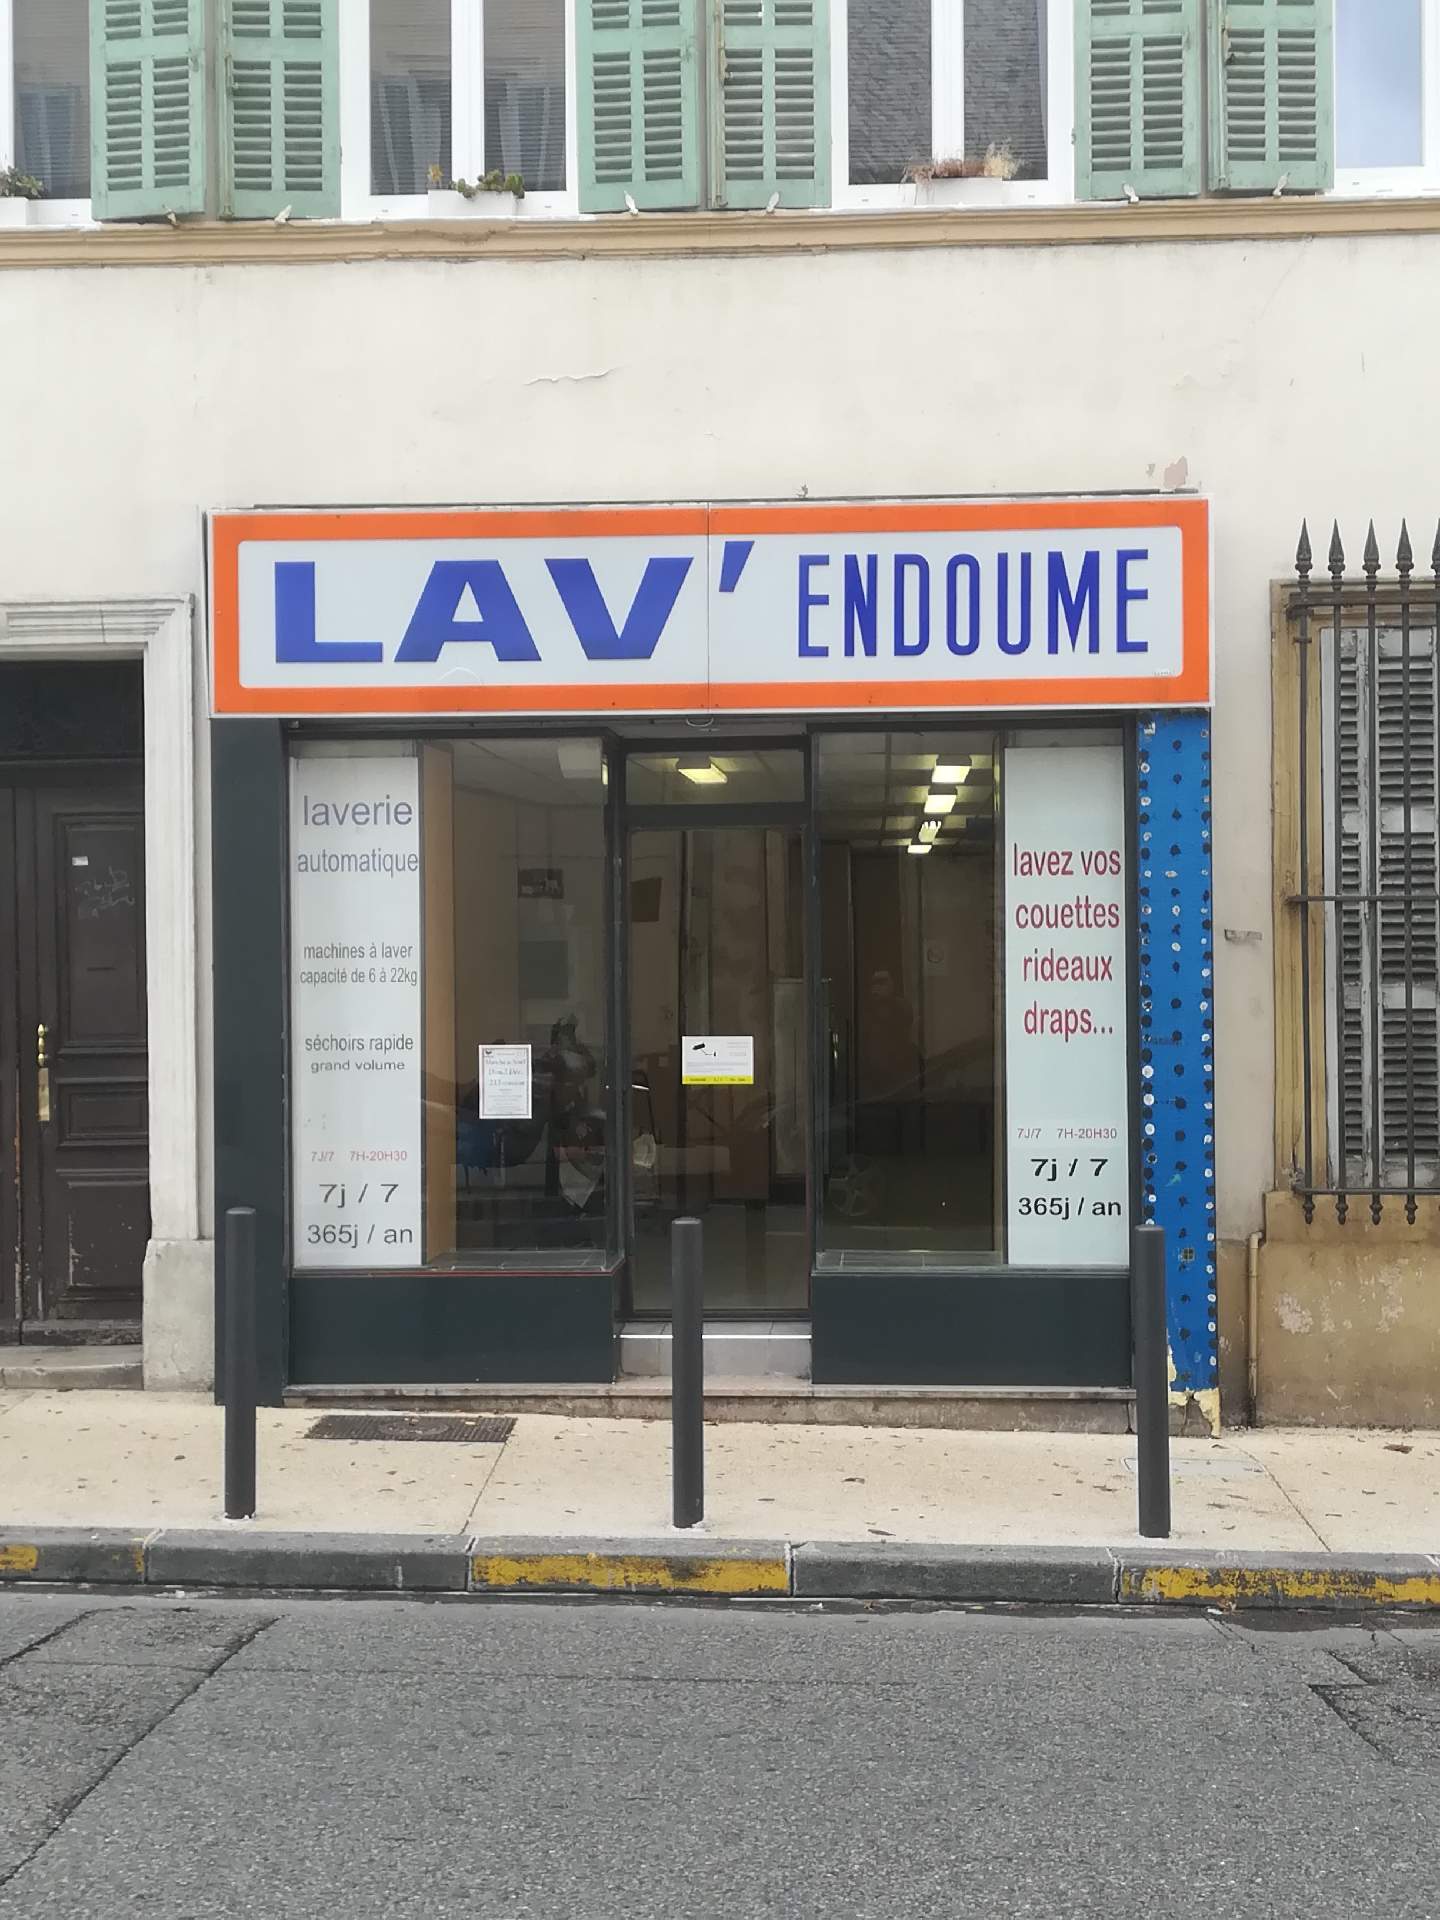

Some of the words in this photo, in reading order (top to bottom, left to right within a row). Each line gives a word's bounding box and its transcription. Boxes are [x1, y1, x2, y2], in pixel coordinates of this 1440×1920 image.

[275, 541, 753, 662] LAV'
[799, 550, 1148, 656] ENDOUME
[303, 794, 413, 826] laverie
[297, 848, 419, 878] automatique
[1013, 842, 1074, 877] lavez
[1080, 850, 1121, 877] vos
[1015, 895, 1120, 929] couettes
[303, 942, 366, 959] machines
[369, 942, 378, 959] à
[381, 942, 414, 959] laver
[299, 967, 348, 988] capacité
[350, 967, 366, 983] de
[368, 967, 377, 983] 6
[379, 967, 388, 983] à
[390, 967, 418, 987] 22kg
[1023, 948, 1113, 982] rideaux
[1024, 1000, 1113, 1043] draps...
[305, 1033, 366, 1052] séchoirs
[369, 1033, 414, 1055] rapide
[310, 1060, 351, 1074] grand
[355, 1060, 406, 1071] volume
[1017, 1128, 1042, 1139] 7J/7
[1057, 1128, 1118, 1139] 7H-20H30
[311, 1151, 335, 1162] 7J/7
[350, 1150, 409, 1161] 7H-20H30
[1030, 1158, 1057, 1182] 7j
[1089, 1158, 1109, 1177] 7
[319, 1183, 346, 1209] 7j
[380, 1183, 400, 1203] 7
[1018, 1197, 1070, 1221] 365j
[1091, 1201, 1122, 1217] an
[307, 1223, 359, 1249] 365j
[383, 1228, 413, 1244] an
